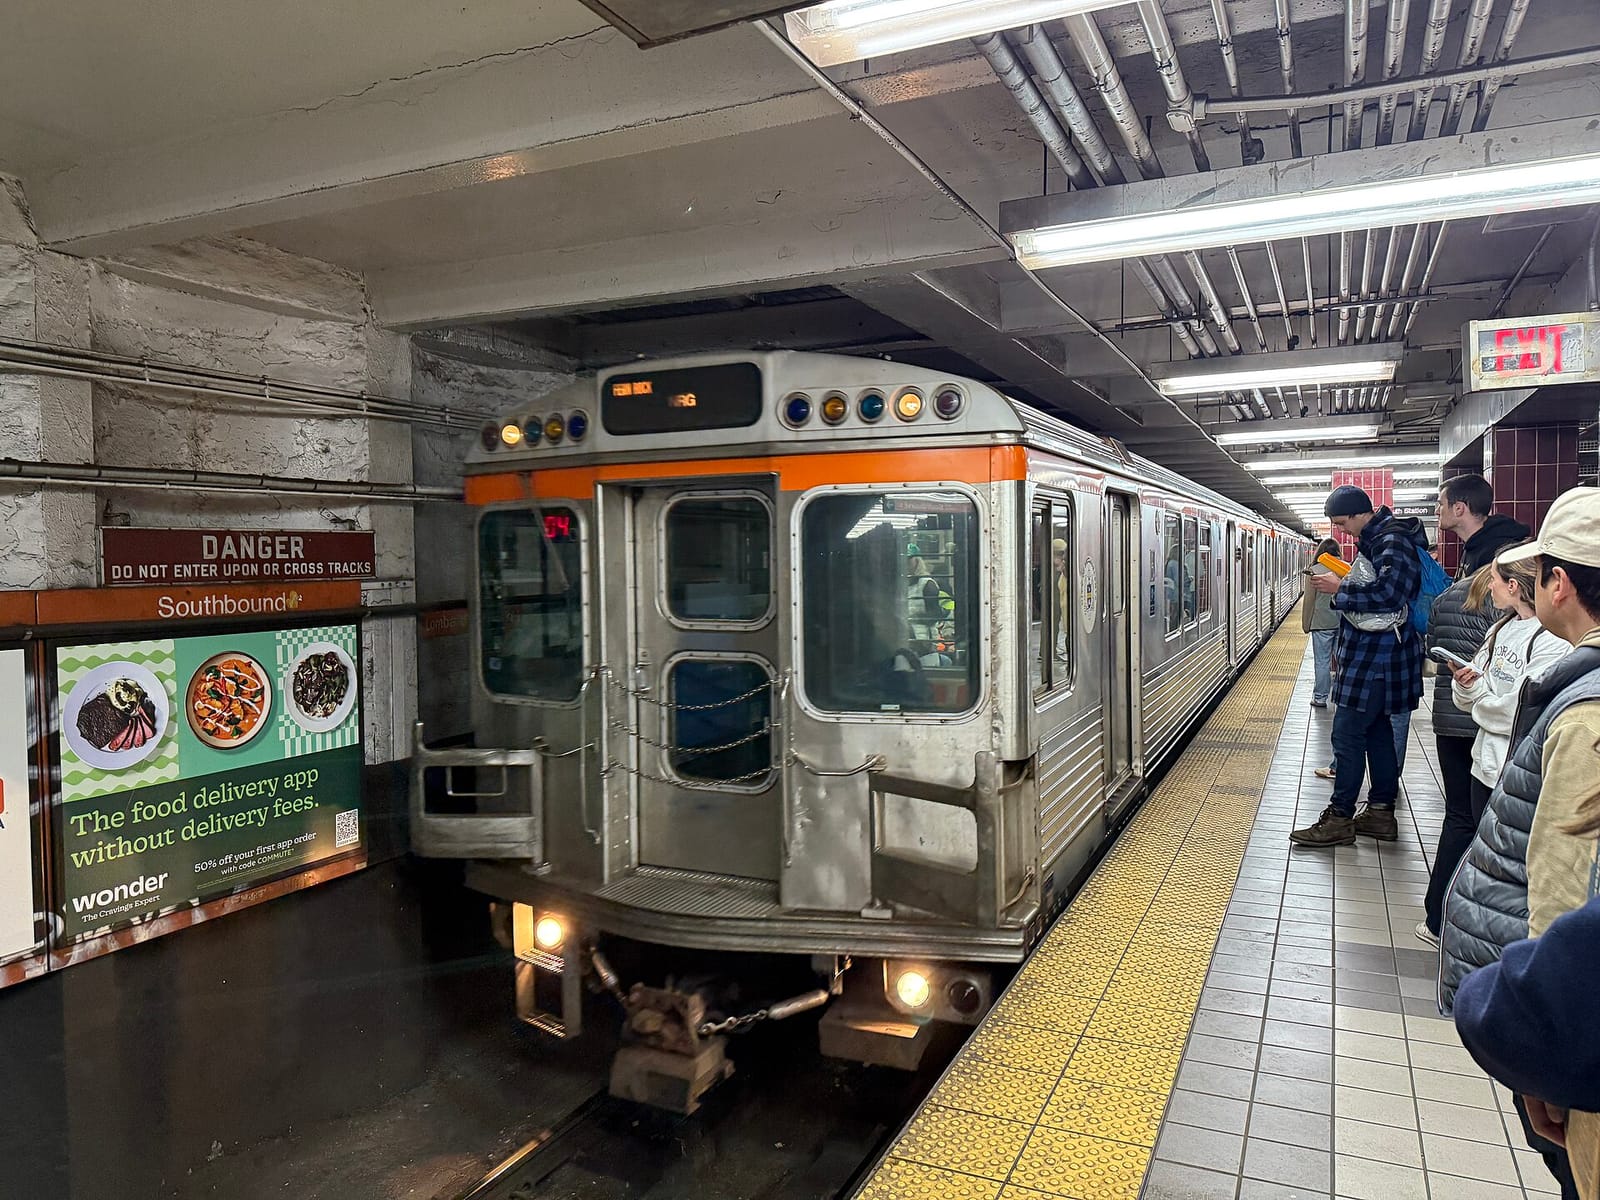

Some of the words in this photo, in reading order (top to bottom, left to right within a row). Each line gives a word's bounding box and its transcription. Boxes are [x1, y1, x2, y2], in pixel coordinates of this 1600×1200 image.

[1494, 324, 1568, 374] EXIT
[1403, 507, 1428, 515] Station
[202, 535, 304, 560] DANGER
[112, 565, 133, 580] DO
[139, 564, 168, 579] NOT
[174, 563, 218, 578] ENTER
[223, 563, 259, 577] UPON
[263, 562, 280, 576] OR
[284, 562, 324, 575] CROSS
[328, 561, 372, 575] TRACKS
[158, 592, 287, 618] Southbound
[70, 810, 126, 837] The
[130, 791, 188, 824] food
[193, 776, 280, 809] delivery
[283, 768, 320, 791] app
[70, 828, 176, 868] without
[181, 804, 270, 841] delivery
[273, 795, 320, 818] fees.
[194, 858, 218, 873] 50%
[218, 853, 234, 867] off
[233, 849, 256, 865] your
[256, 844, 276, 856] first
[277, 840, 293, 853] app
[293, 832, 317, 844] order
[220, 865, 238, 876] with
[238, 860, 257, 872] code
[71, 872, 169, 913] wonder
[81, 912, 98, 924] The
[98, 903, 134, 918] Cravings
[134, 895, 161, 909] Expert
